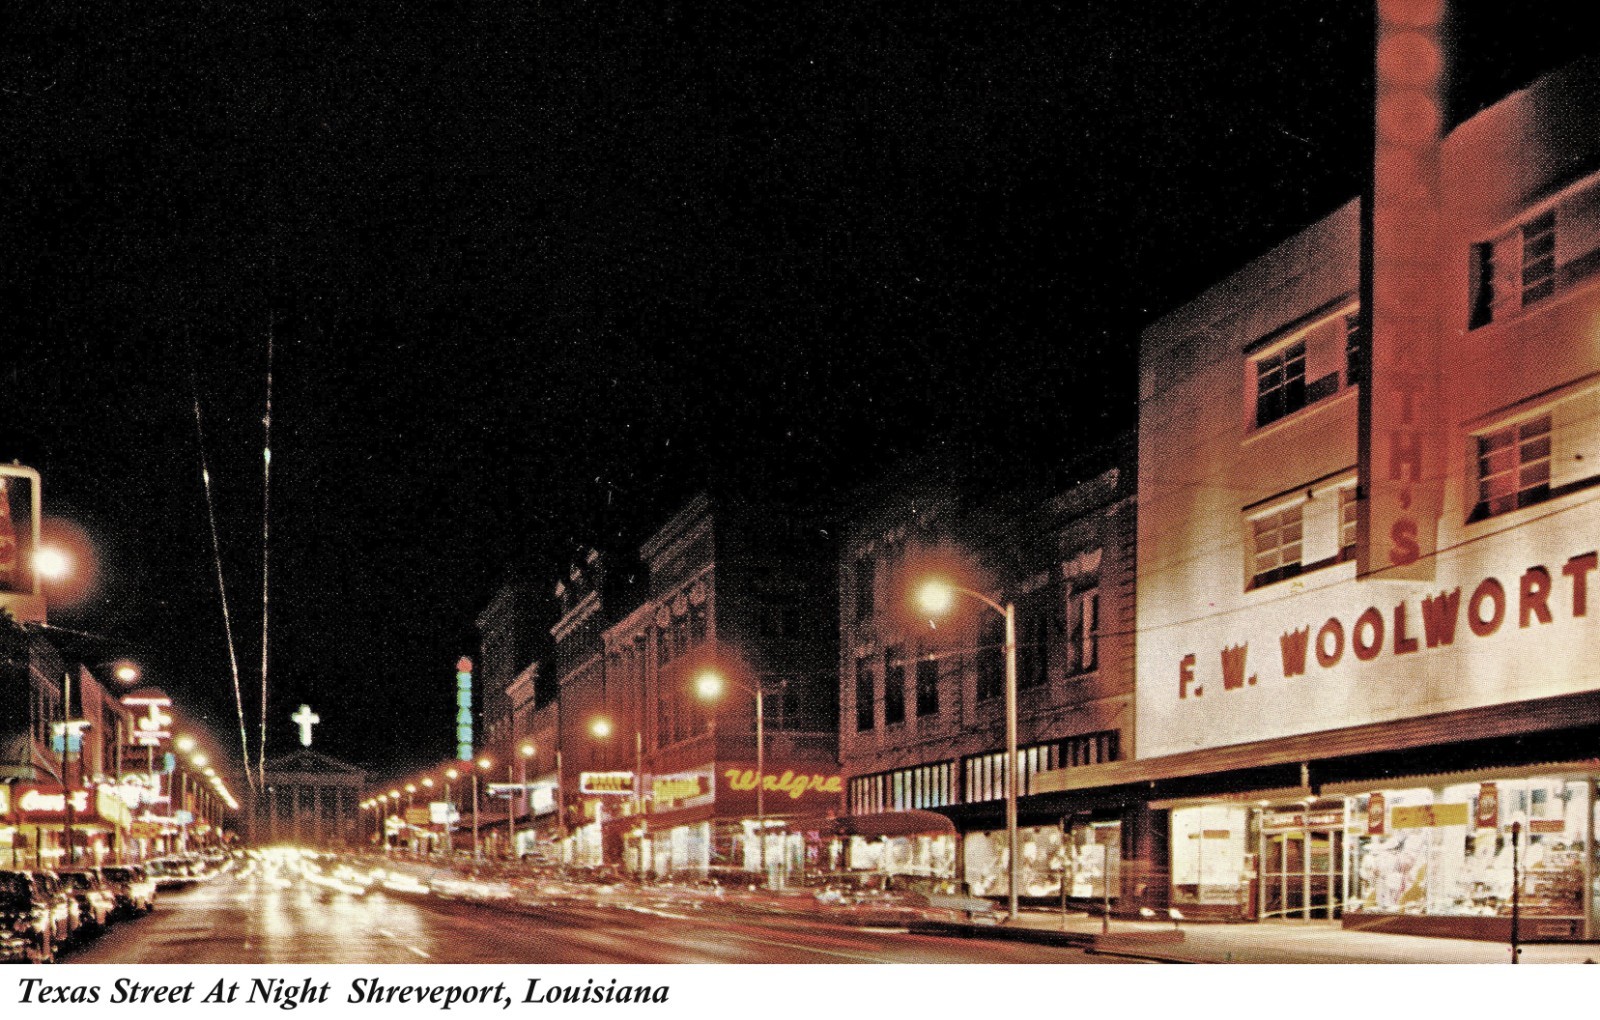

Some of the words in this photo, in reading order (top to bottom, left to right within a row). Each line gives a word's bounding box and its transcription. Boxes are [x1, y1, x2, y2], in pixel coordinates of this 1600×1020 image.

[1178, 653, 1204, 700] F.
[1220, 640, 1258, 692] W.
[1279, 550, 1599, 678] WOOLWORT
[724, 769, 842, 799] Walgre
